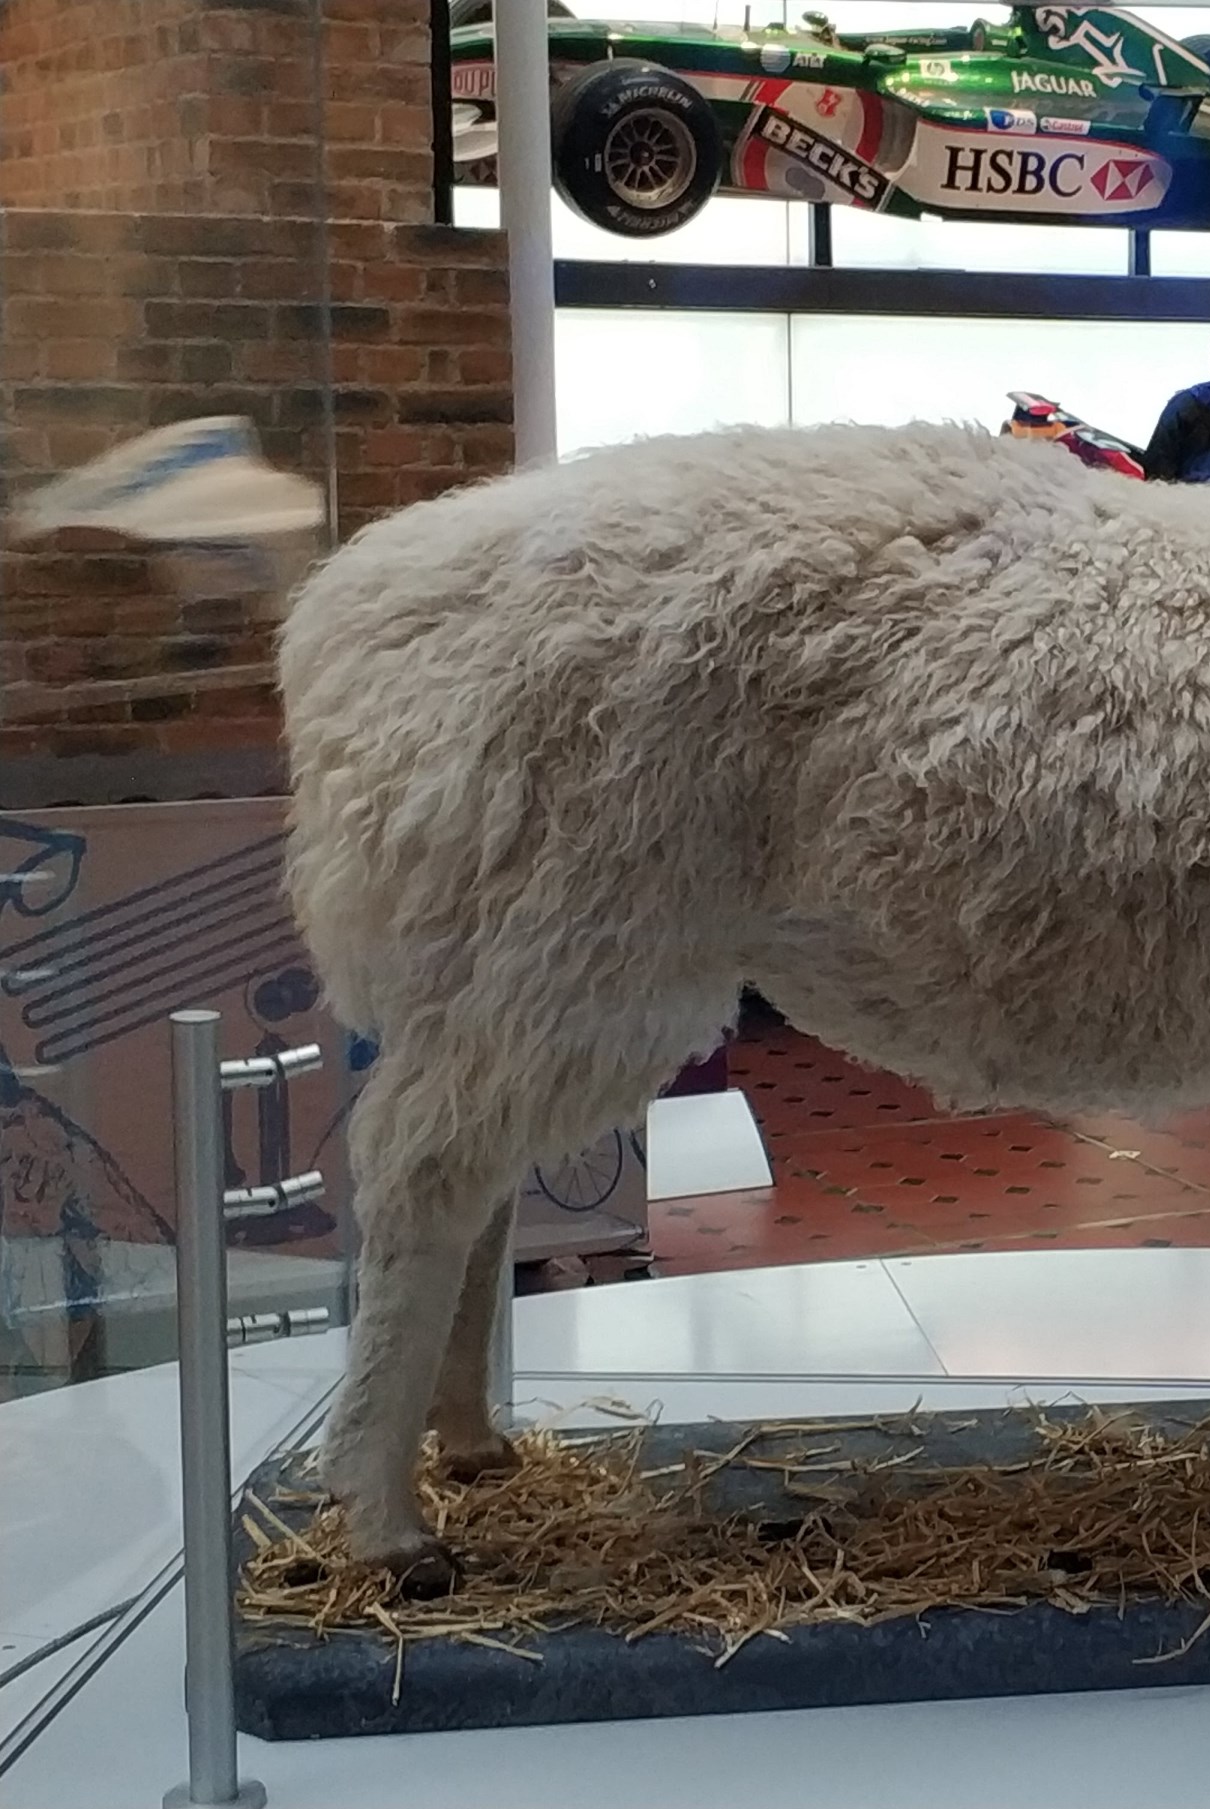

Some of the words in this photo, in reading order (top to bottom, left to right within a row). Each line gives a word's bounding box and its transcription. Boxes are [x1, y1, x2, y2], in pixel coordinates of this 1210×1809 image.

[617, 86, 693, 109] MICHELIN
[1011, 70, 1097, 98] JAGUAR
[761, 115, 879, 200] BECK'S
[940, 145, 1085, 198] HSBC
